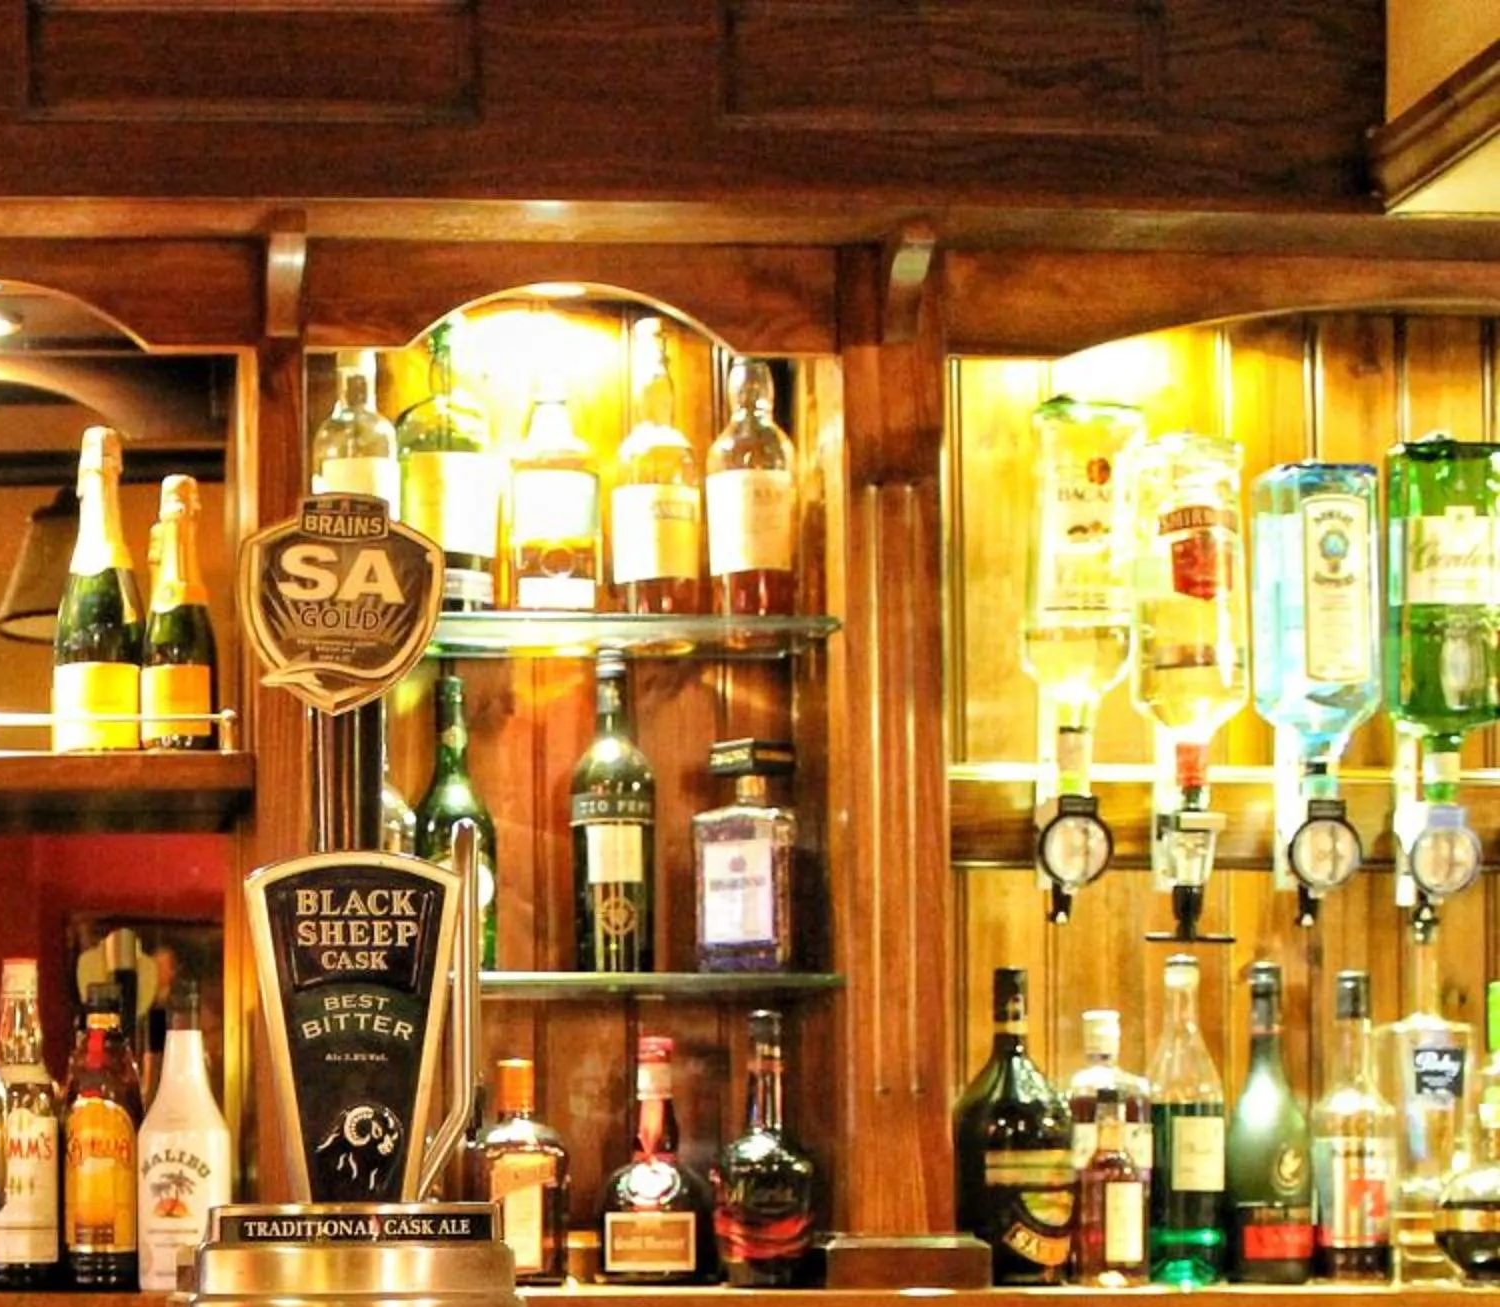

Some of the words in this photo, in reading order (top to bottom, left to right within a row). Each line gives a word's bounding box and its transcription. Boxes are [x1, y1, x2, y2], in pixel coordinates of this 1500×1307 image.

[305, 515, 382, 537] BRAINS
[278, 543, 405, 605] SA
[301, 607, 381, 632] GOLD
[296, 889, 417, 916] BLACK
[297, 920, 419, 947] SHEEP
[321, 951, 389, 970] CASK
[323, 993, 390, 1011] BEST
[301, 1012, 415, 1041] BITTER
[8, 1132, 53, 1160] MM'S
[142, 1148, 211, 1180] MALIBU
[244, 1220, 381, 1238] TRADITIONAL
[384, 1218, 435, 1236] CASK
[437, 1218, 471, 1235] ALE
